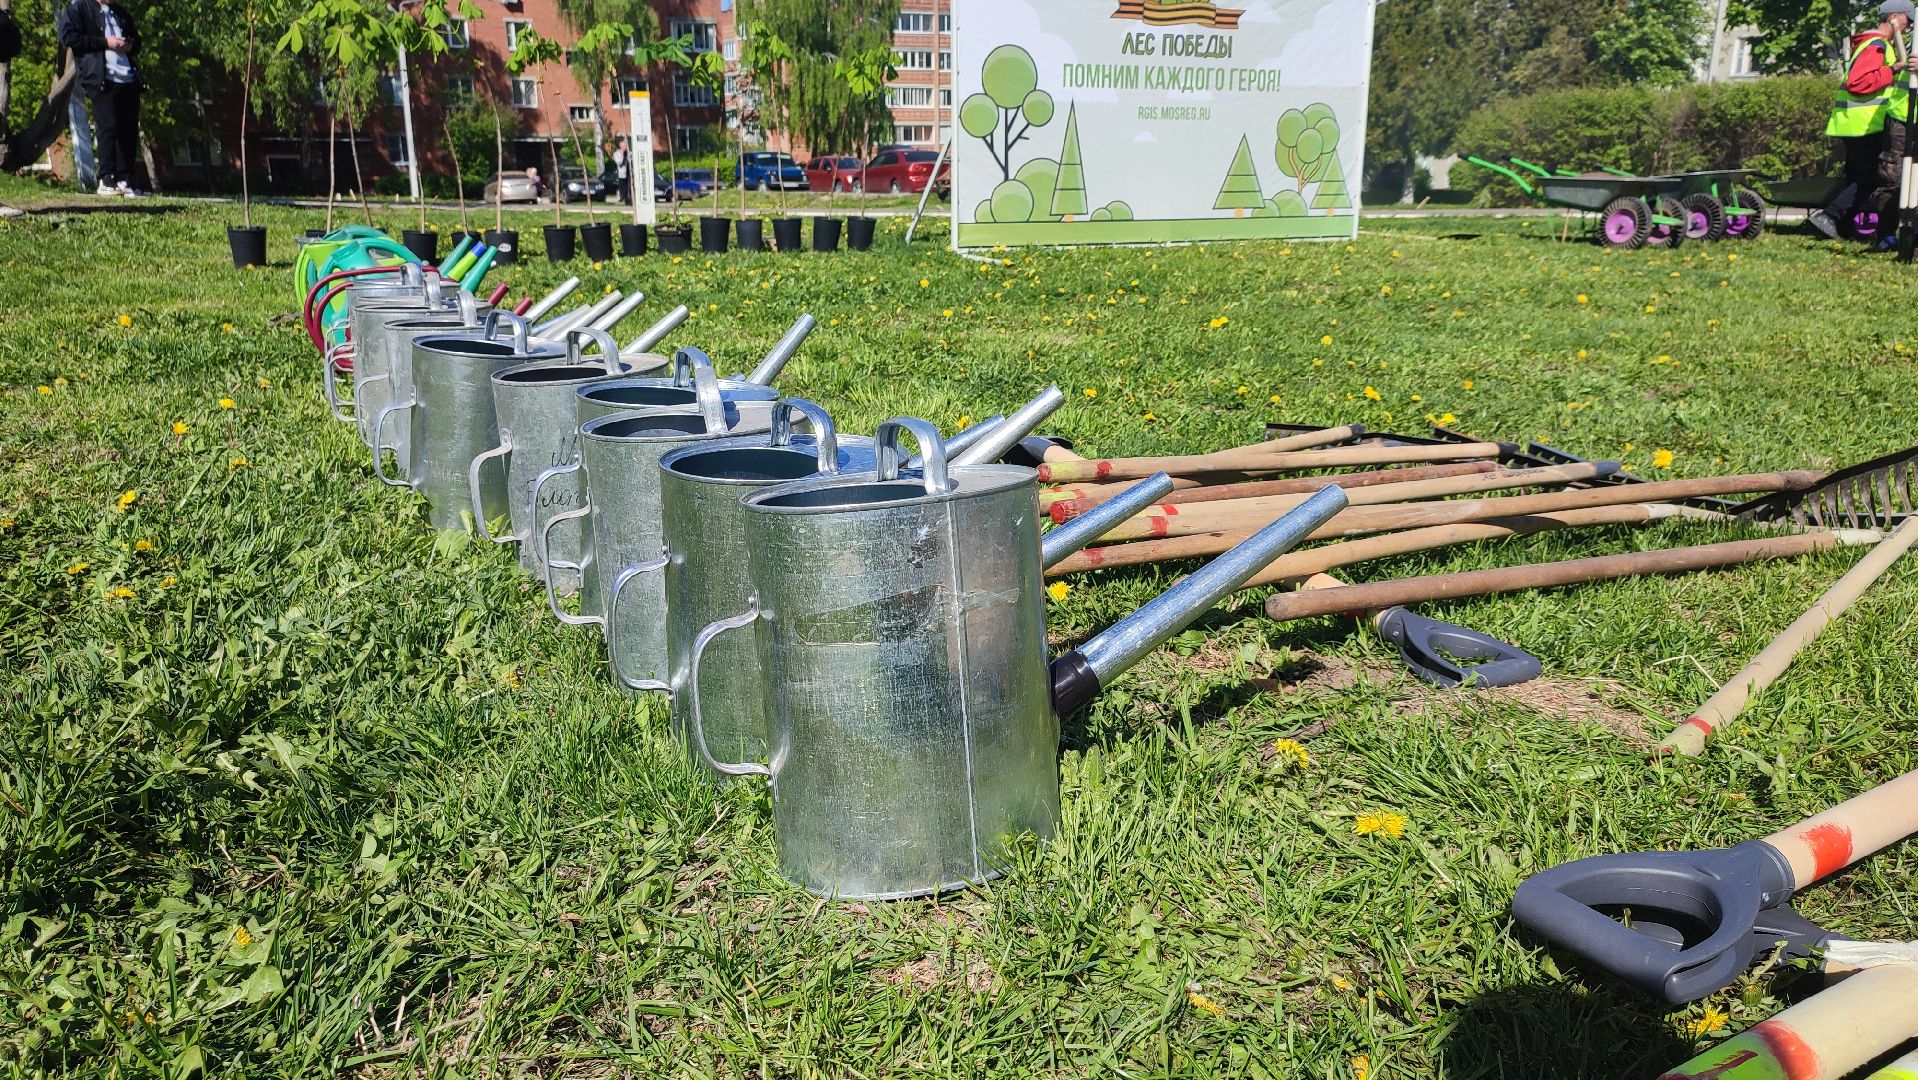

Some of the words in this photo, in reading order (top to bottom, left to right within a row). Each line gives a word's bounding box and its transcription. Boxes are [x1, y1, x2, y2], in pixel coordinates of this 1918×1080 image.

[1121, 32, 1156, 56] ЛЕС
[1162, 34, 1233, 59] ПОБЕДЫ
[1063, 63, 1139, 89] ПОМНИМ
[1144, 65, 1225, 93] КАЖДОГО
[1229, 68, 1281, 92] ГЕРОЯ!
[1137, 106, 1211, 121] RGIS.MOSREG.RU
